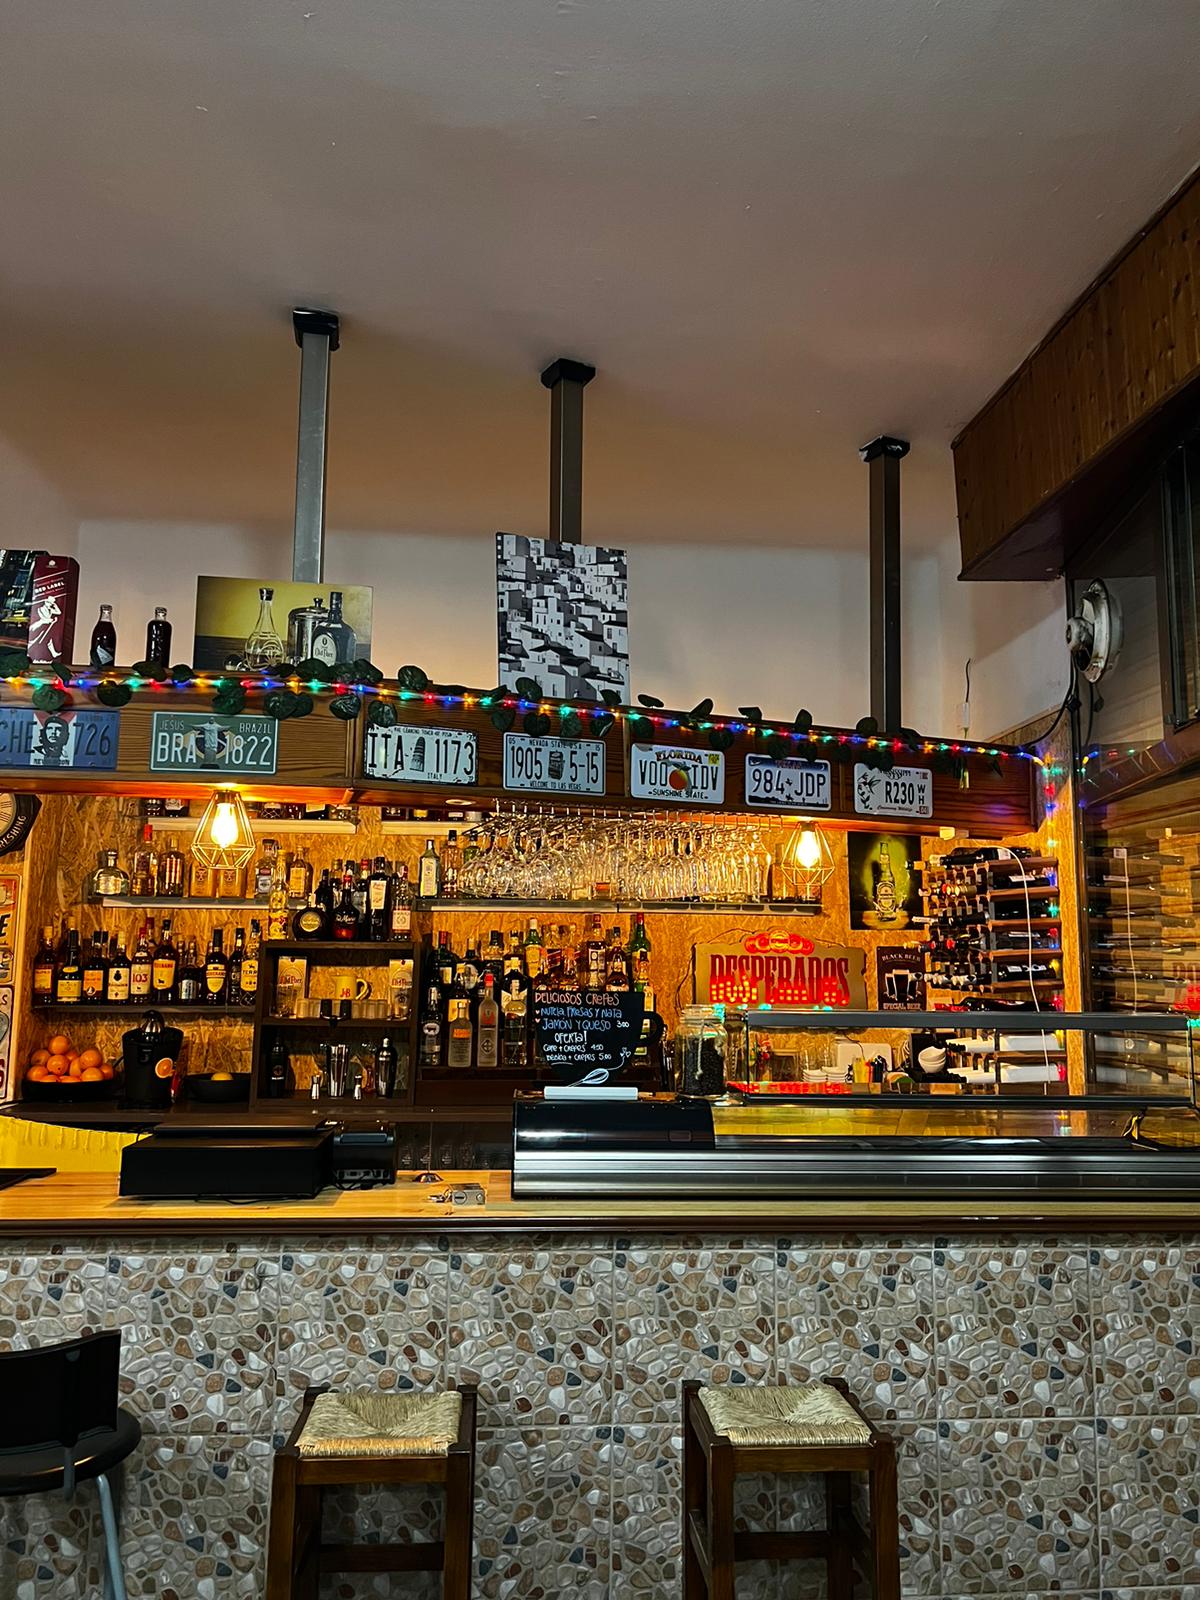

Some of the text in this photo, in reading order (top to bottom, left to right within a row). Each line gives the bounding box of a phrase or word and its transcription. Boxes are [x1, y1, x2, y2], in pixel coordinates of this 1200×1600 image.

[34, 581, 64, 594] RED LABEL
[159, 719, 272, 734] JESUS BRAZIL
[0, 720, 111, 756] CHE 726
[529, 738, 549, 748] NEVADA
[157, 732, 272, 766] BRA 1822
[367, 732, 475, 776] ITA 1173
[655, 749, 703, 765] FLORIDA
[510, 745, 599, 784] 1905 5-15
[427, 772, 443, 780] ITALY
[529, 780, 548, 788] WELCOME
[551, 781, 557, 789] TO
[559, 782, 567, 790] LAS
[752, 768, 826, 798] 984 JDP
[652, 788, 704, 800] SUNSHINE STATE
[885, 781, 915, 805] R230
[904, 954, 921, 962] BEER
[132, 973, 149, 983] 103
[710, 954, 850, 1006] DESPERADOS
[534, 992, 582, 1005] DELICIOSOS
[882, 1002, 920, 1010] SPECIAL BEER
[594, 1008, 600, 1018] Y
[575, 1020, 581, 1030] Y
